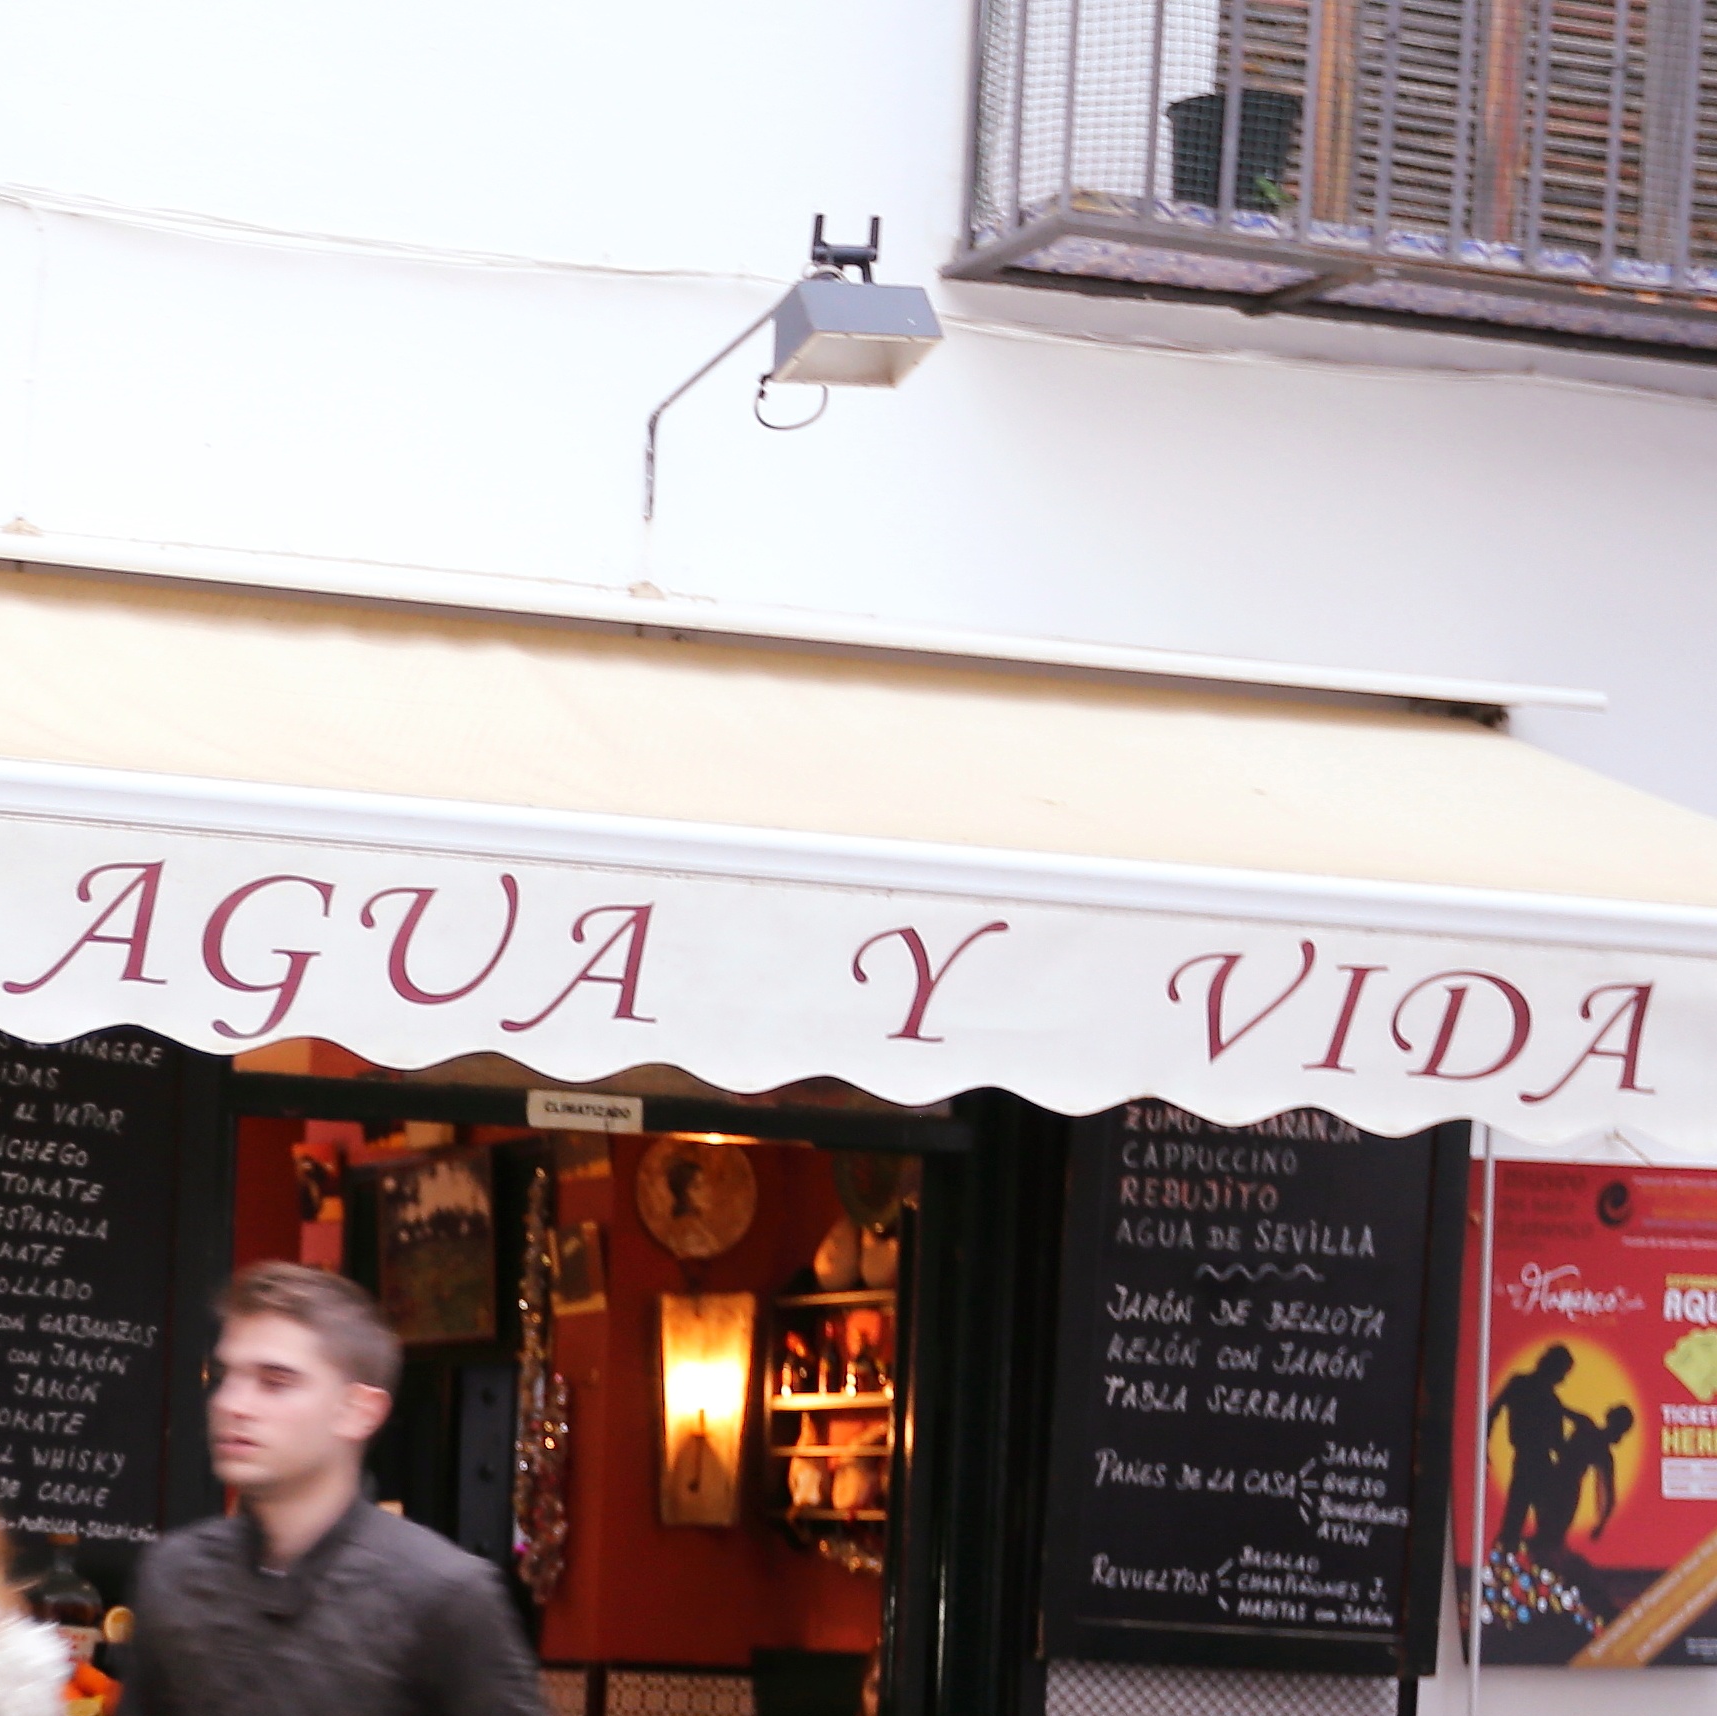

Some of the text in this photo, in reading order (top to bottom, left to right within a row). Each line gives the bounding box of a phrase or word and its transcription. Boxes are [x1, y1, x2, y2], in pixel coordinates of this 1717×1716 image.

[2, 859, 658, 1040] AGUA
[852, 920, 1011, 1044] Y
[1167, 939, 1657, 1104] VIDA
[0, 1170, 106, 1204] TOMATE
[1115, 1217, 1195, 1250] AGUA
[1254, 1218, 1376, 1258] SEVILLA
[1103, 1374, 1339, 1426] TABLA SERRANA
